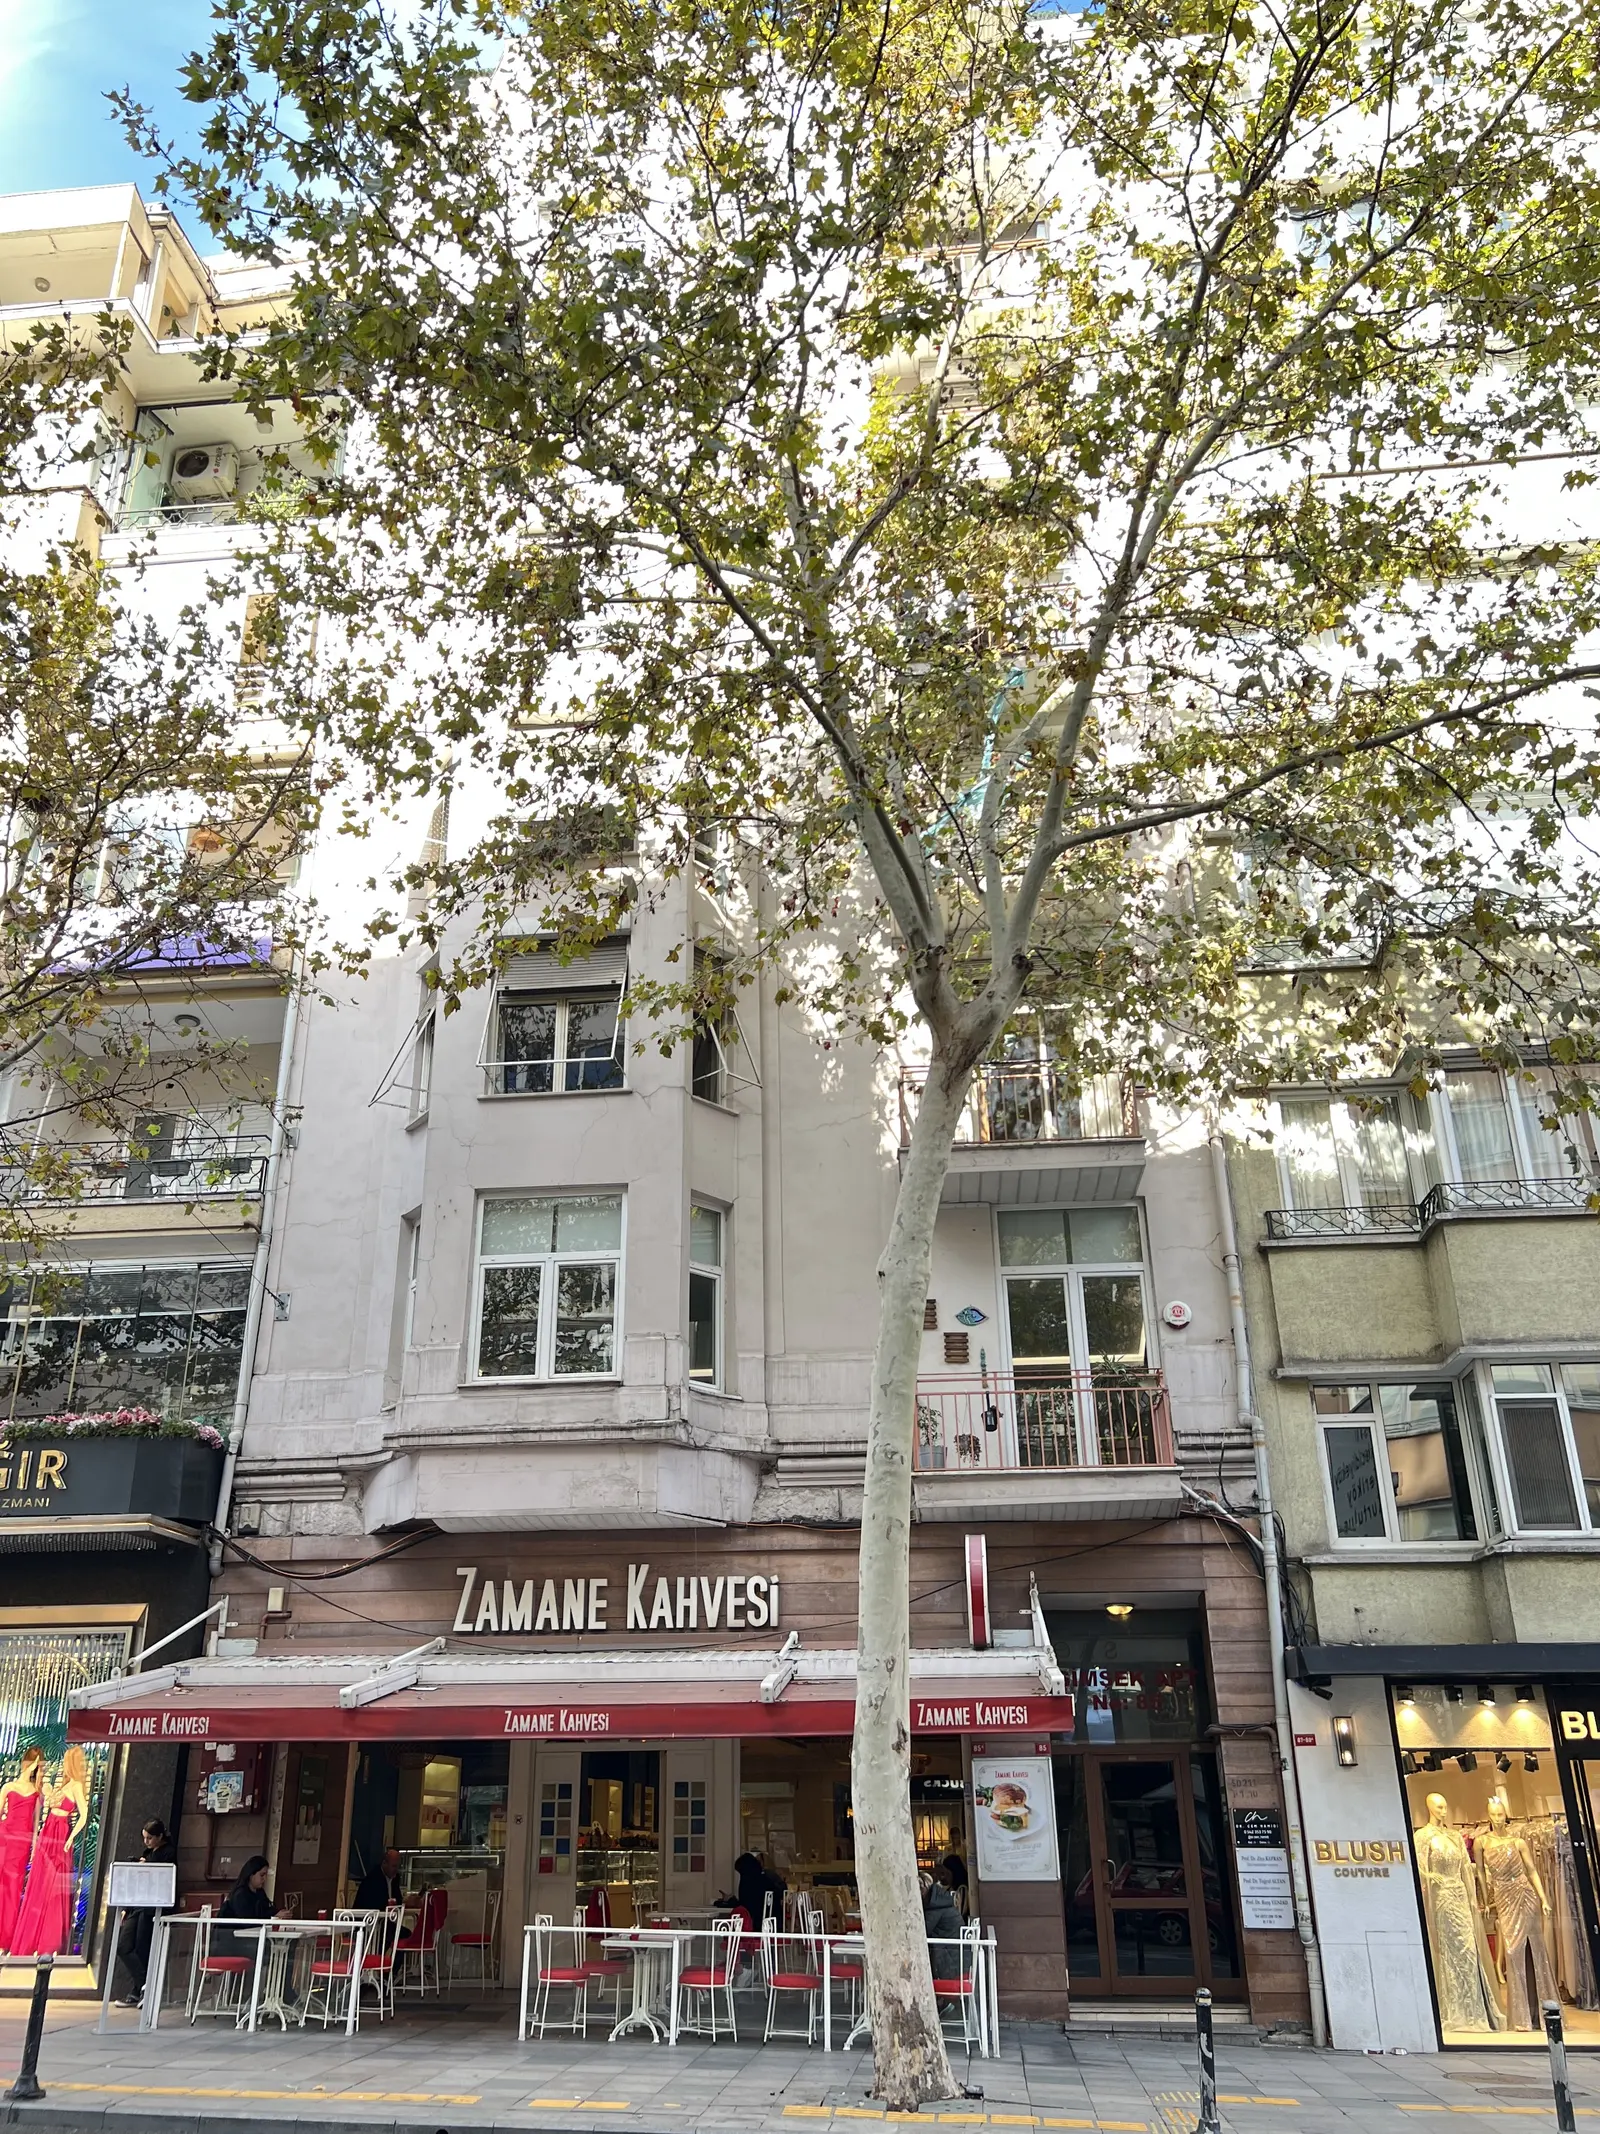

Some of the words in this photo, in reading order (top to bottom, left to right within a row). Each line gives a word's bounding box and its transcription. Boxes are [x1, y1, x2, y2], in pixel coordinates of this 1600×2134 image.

[1, 1497, 50, 1508] ZMANI
[452, 1566, 609, 1632] ZAMANE
[626, 1563, 780, 1630] KAHVESİ
[1092, 1694, 1128, 1710] No:
[108, 1713, 157, 1735] ZAMANE
[504, 1710, 555, 1732] ZAMANE
[559, 1709, 609, 1732] KAHVESİ
[917, 1703, 971, 1727] ZAMANE
[975, 1702, 1028, 1725] KAHVESİ
[1560, 1711, 1600, 1740] BL
[1314, 1840, 1405, 1863] BLUSH
[1334, 1867, 1390, 1878] COUTURE
